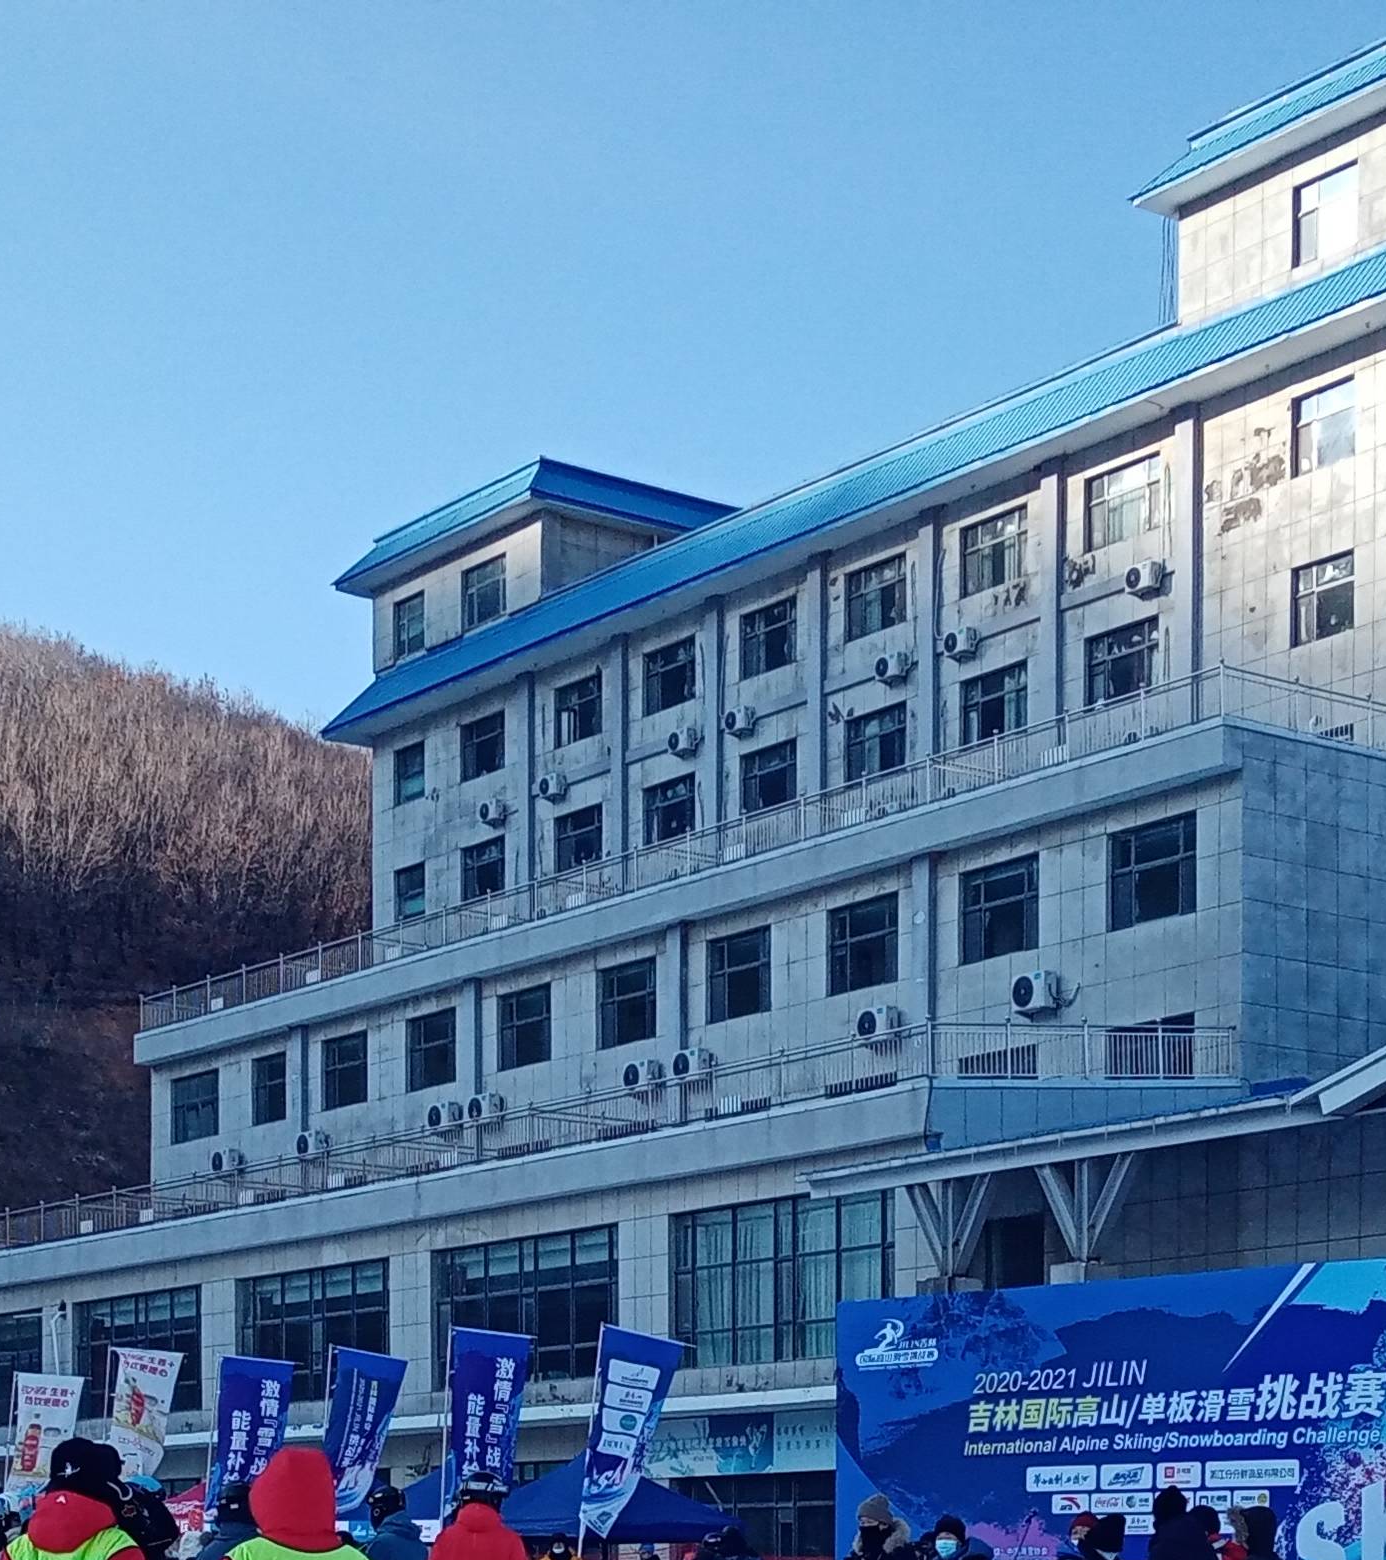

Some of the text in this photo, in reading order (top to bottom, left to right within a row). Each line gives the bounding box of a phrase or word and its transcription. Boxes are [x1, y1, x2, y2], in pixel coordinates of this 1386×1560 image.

[973, 1359, 1148, 1395] 2020-2021 JILIN
[964, 1426, 1381, 1457] International Alpine Skiing/Snowboarding Challenge
